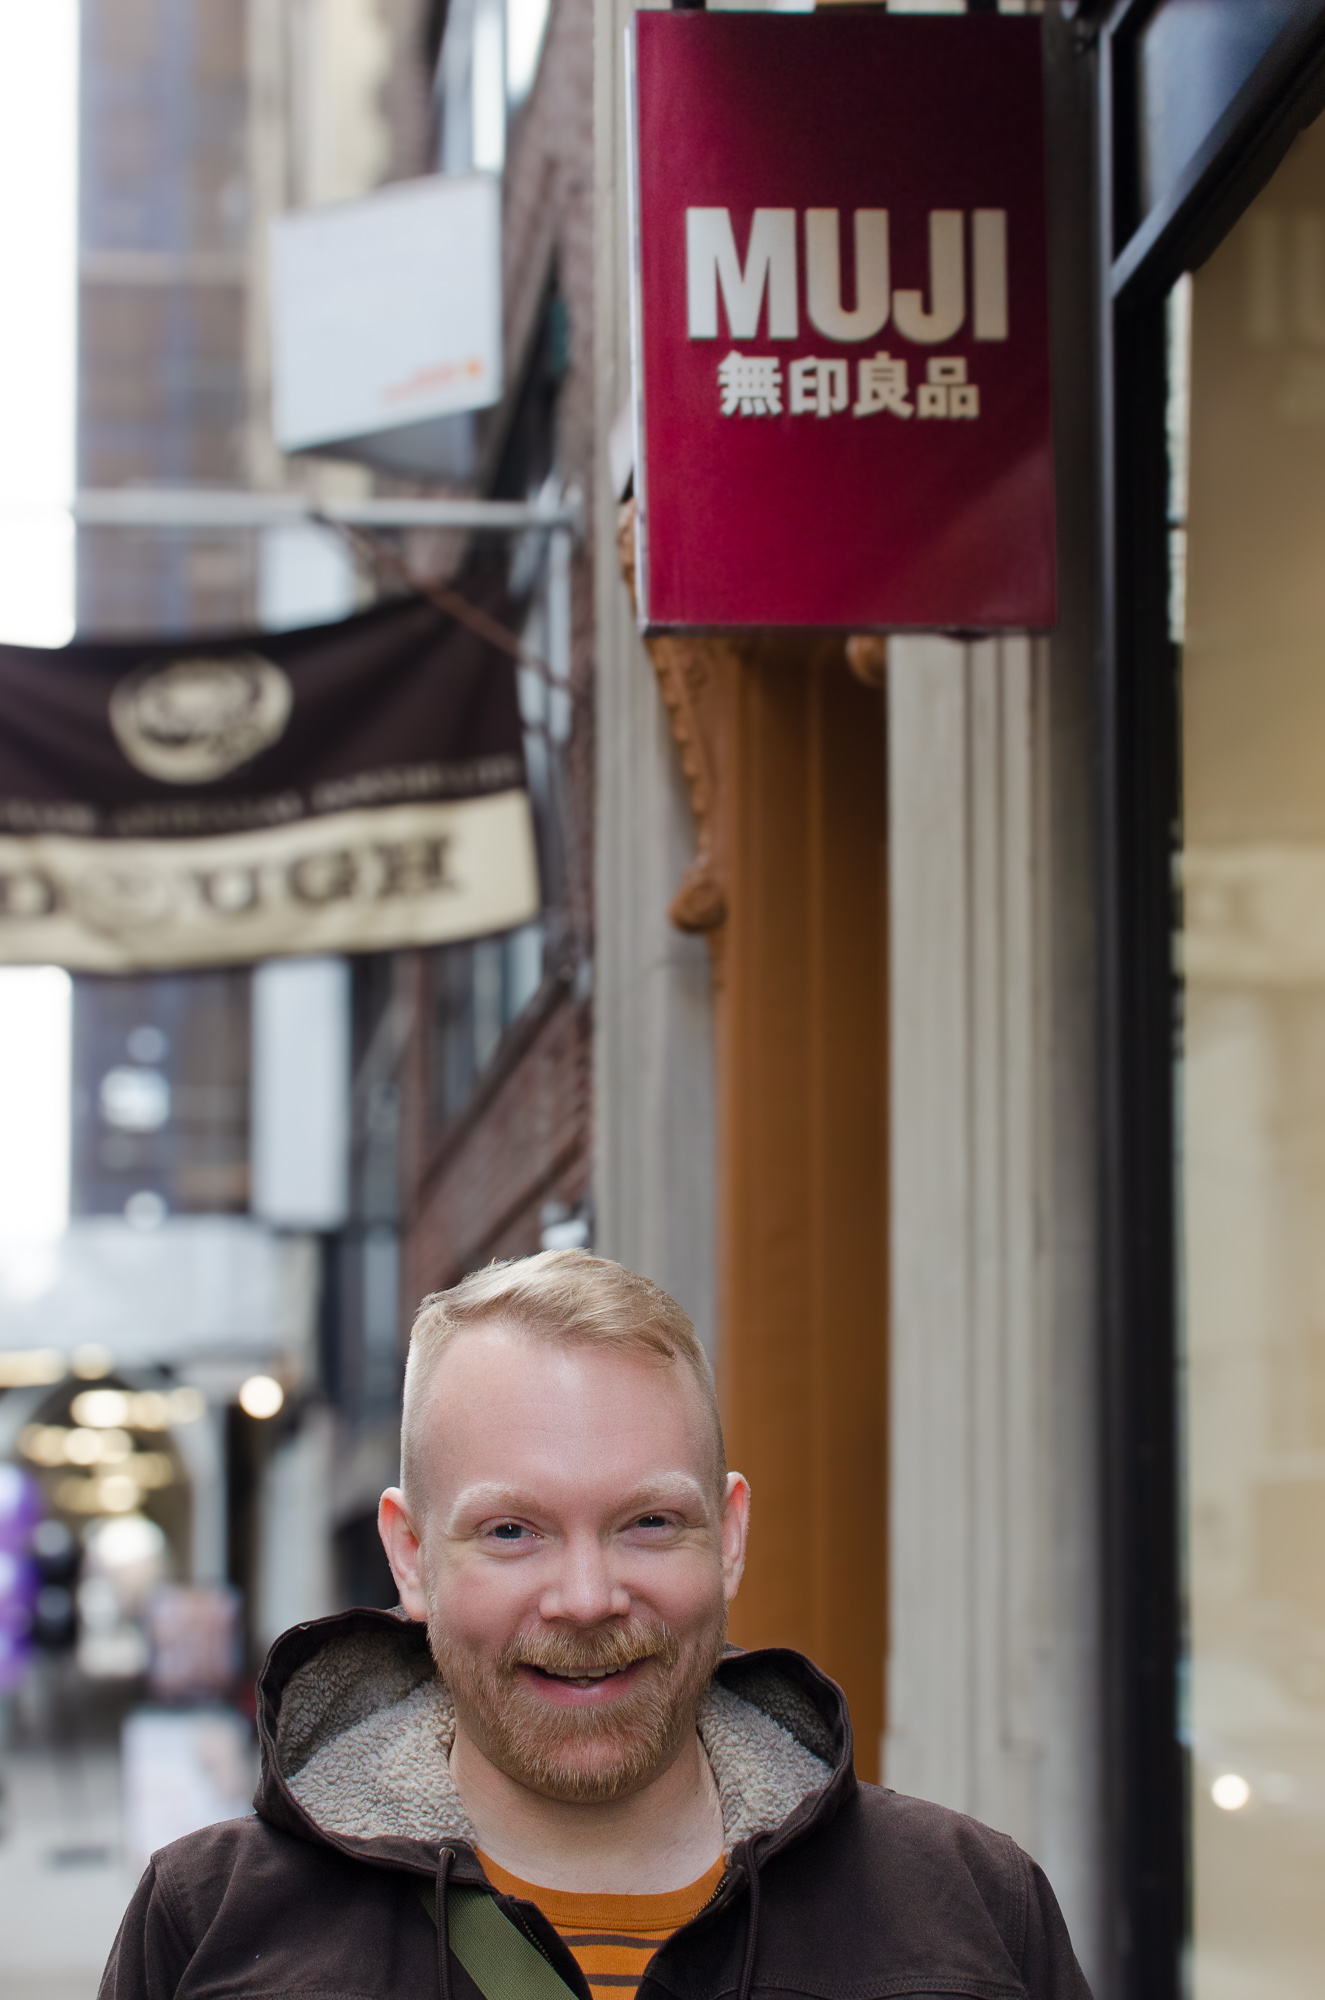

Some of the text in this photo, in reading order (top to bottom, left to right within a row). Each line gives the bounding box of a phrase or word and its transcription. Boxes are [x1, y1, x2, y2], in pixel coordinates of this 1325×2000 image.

[686, 206, 1009, 344] MUJI
[717, 350, 980, 419] 無印良品
